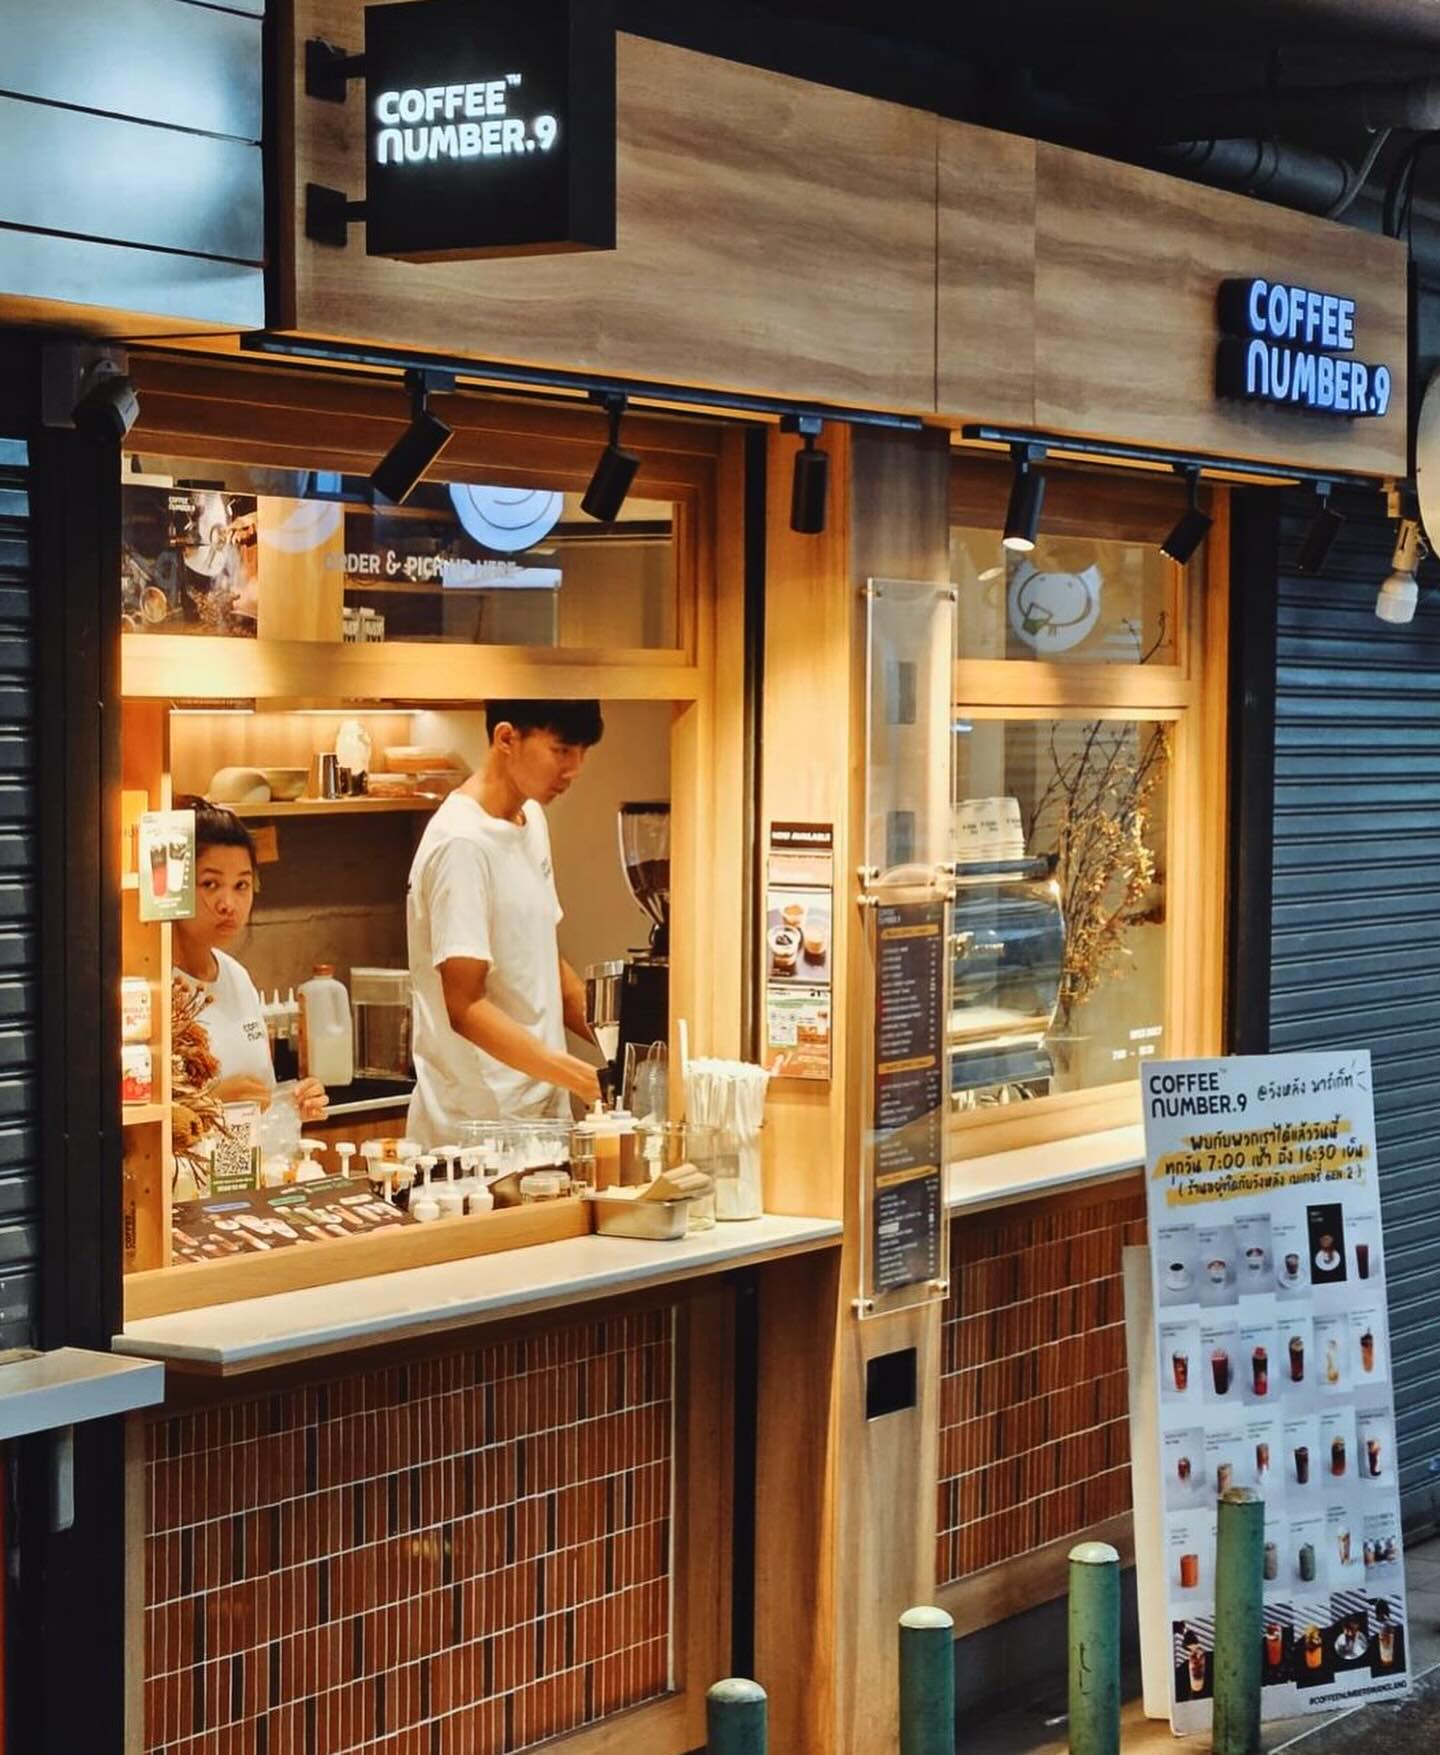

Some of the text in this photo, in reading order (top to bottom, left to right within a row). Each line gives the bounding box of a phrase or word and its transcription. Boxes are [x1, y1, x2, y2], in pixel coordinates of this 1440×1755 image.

[377, 81, 506, 124] COFFEE
[377, 115, 558, 164] NUMBER.9
[1249, 279, 1355, 350] COFFEE
[1247, 339, 1391, 415] NUMBER.9
[1149, 1072, 1219, 1095] COFFEE
[1151, 1093, 1247, 1118] NUMBER.9
[1207, 1152, 1246, 1171] 7:00
[1299, 1143, 1337, 1163] 16:30
